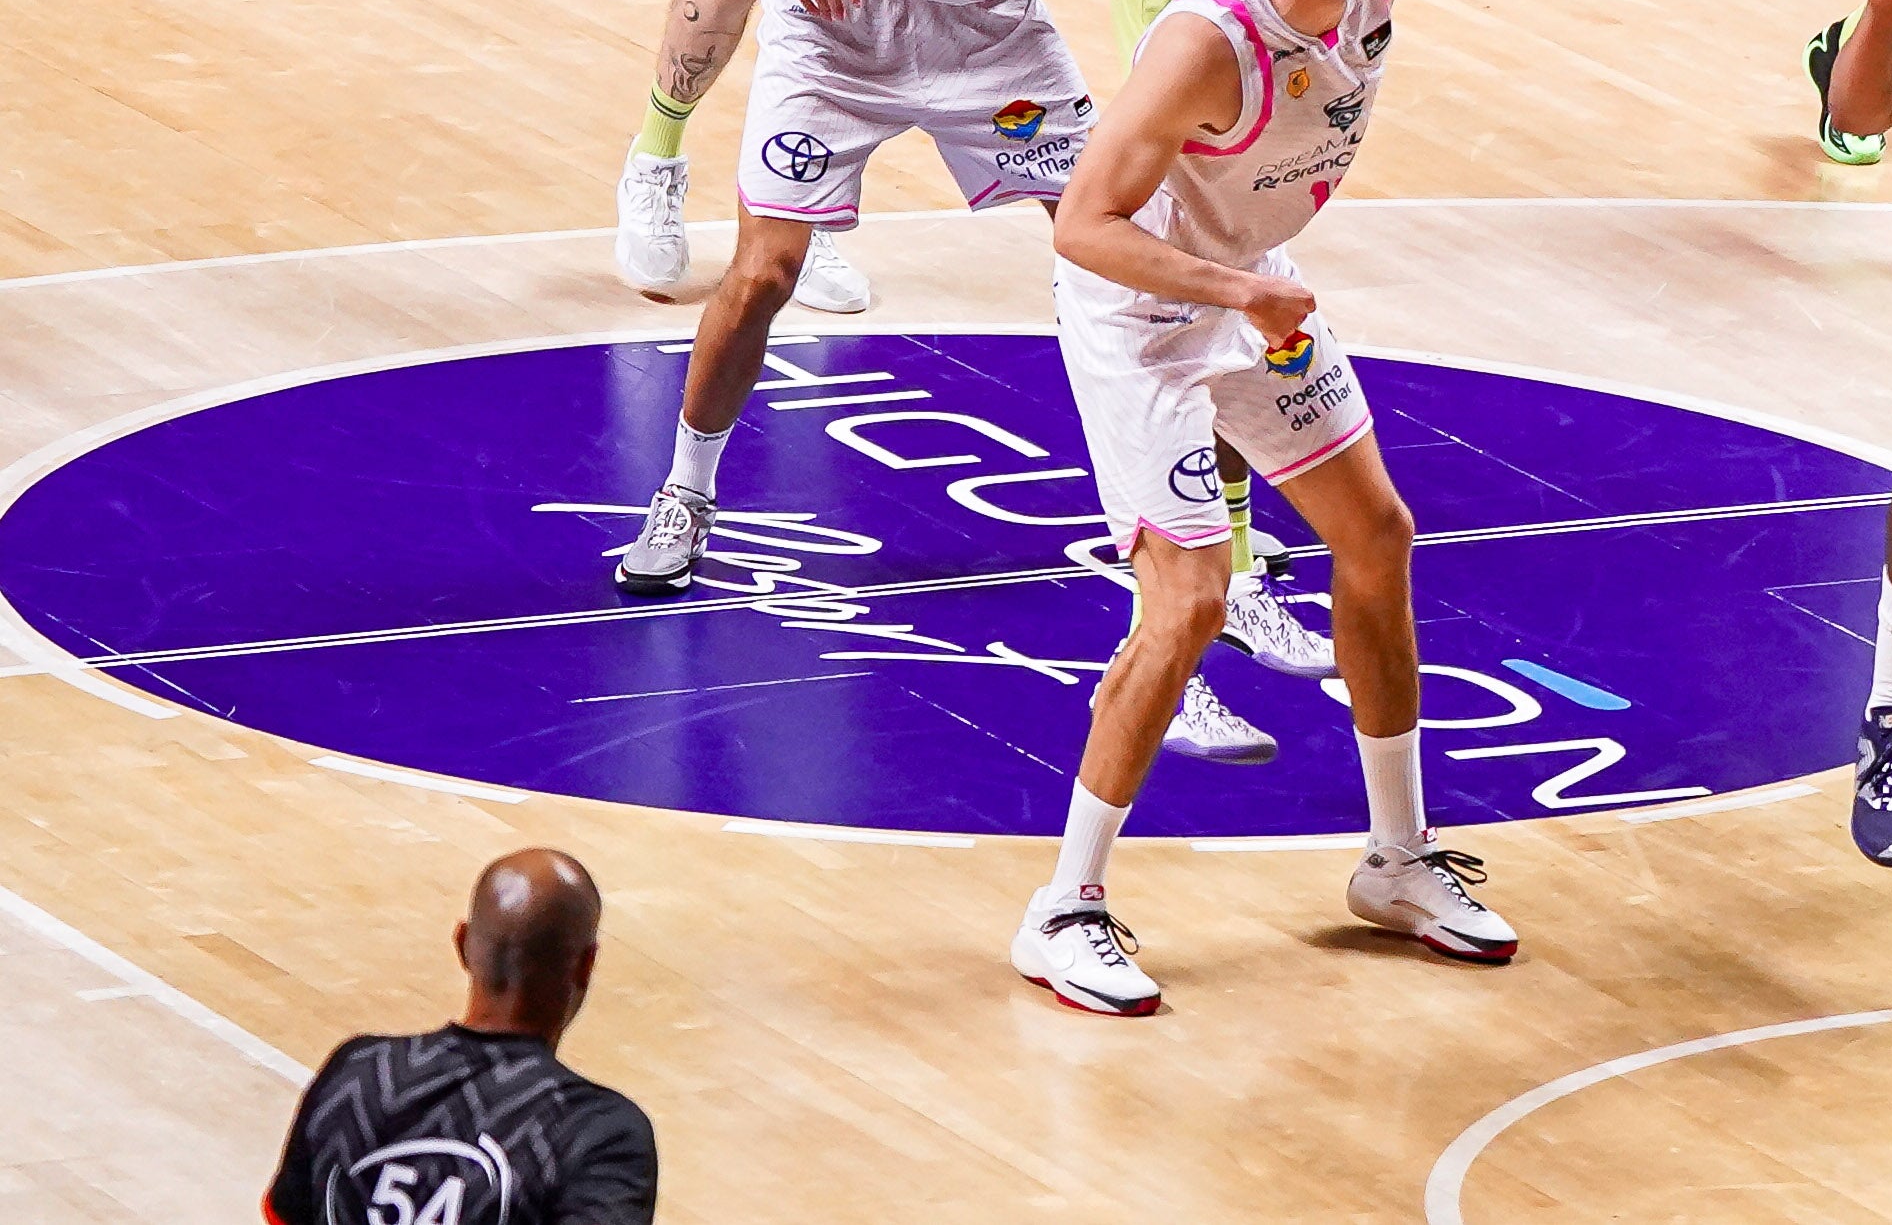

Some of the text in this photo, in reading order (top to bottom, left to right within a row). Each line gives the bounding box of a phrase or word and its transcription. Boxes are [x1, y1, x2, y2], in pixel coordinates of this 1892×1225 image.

[996, 136, 1070, 171] Poema
[1037, 153, 1076, 177] Mar
[1275, 362, 1342, 416] Poema
[1290, 383, 1352, 431] del Mar
[366, 1163, 466, 1225] 54
